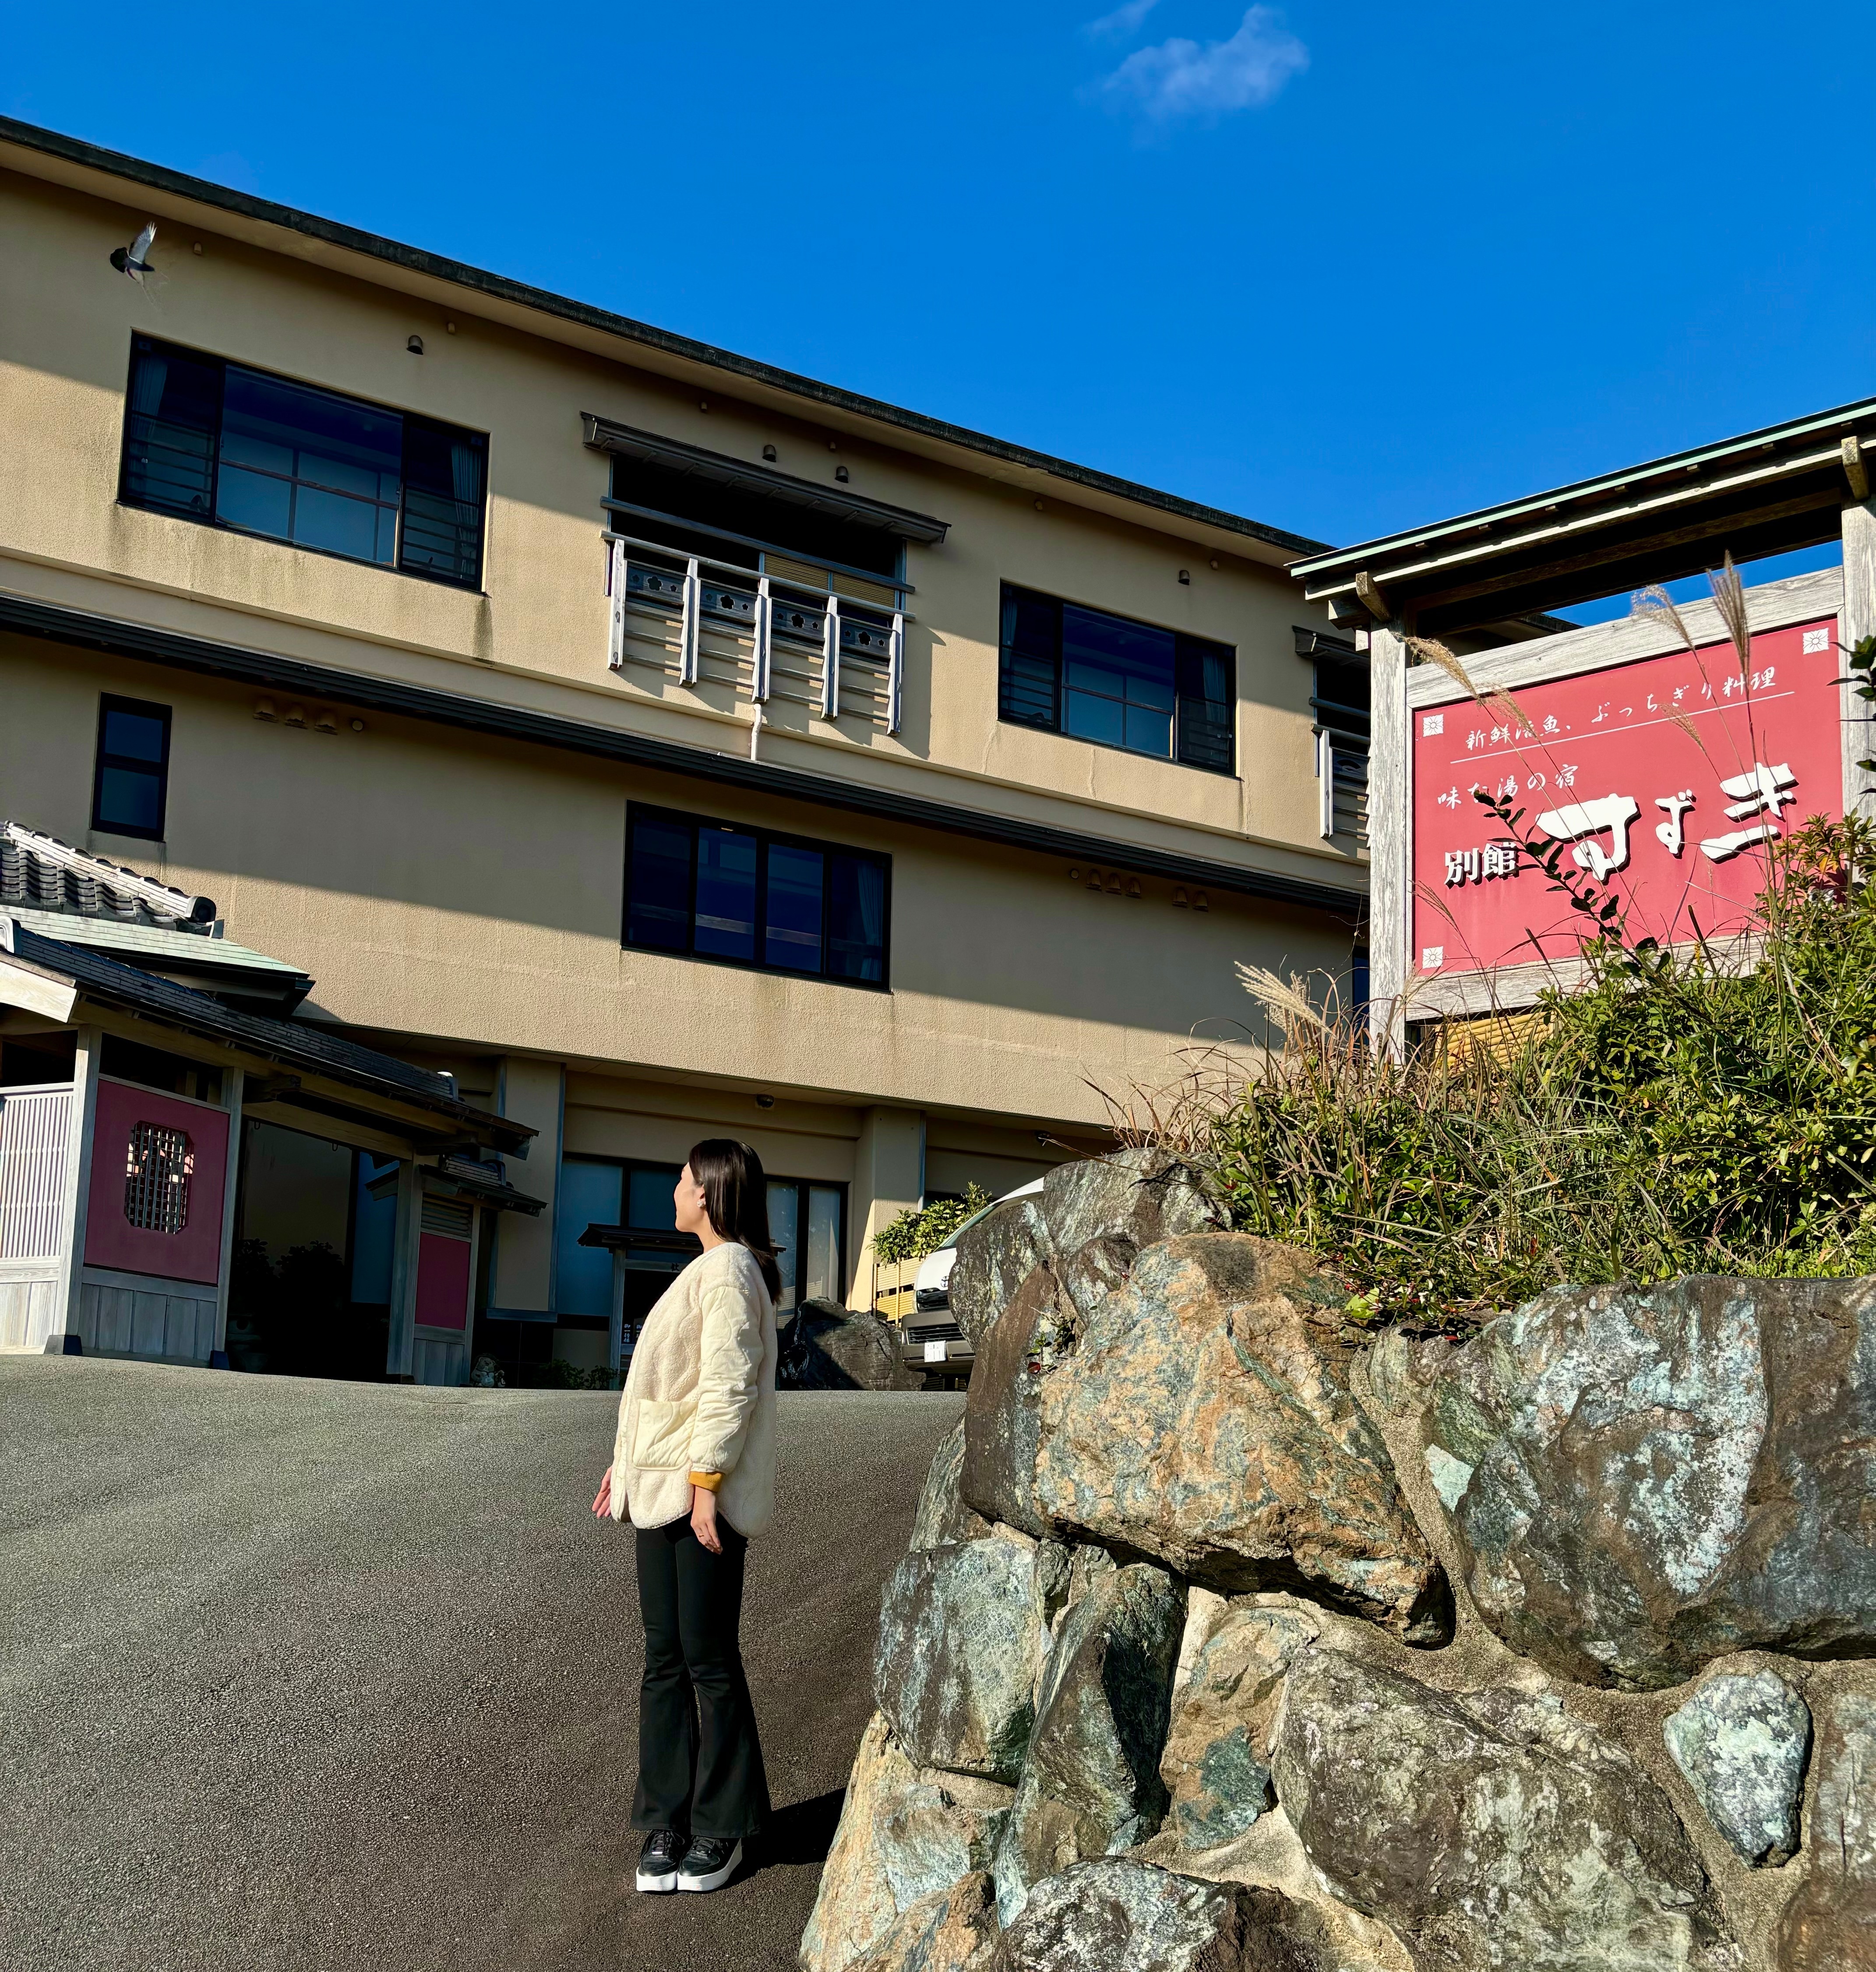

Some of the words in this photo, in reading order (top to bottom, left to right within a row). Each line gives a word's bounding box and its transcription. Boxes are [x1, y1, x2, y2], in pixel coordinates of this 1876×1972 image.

[1444, 842, 1517, 885] 別館
[1535, 762, 1795, 881] すずき
